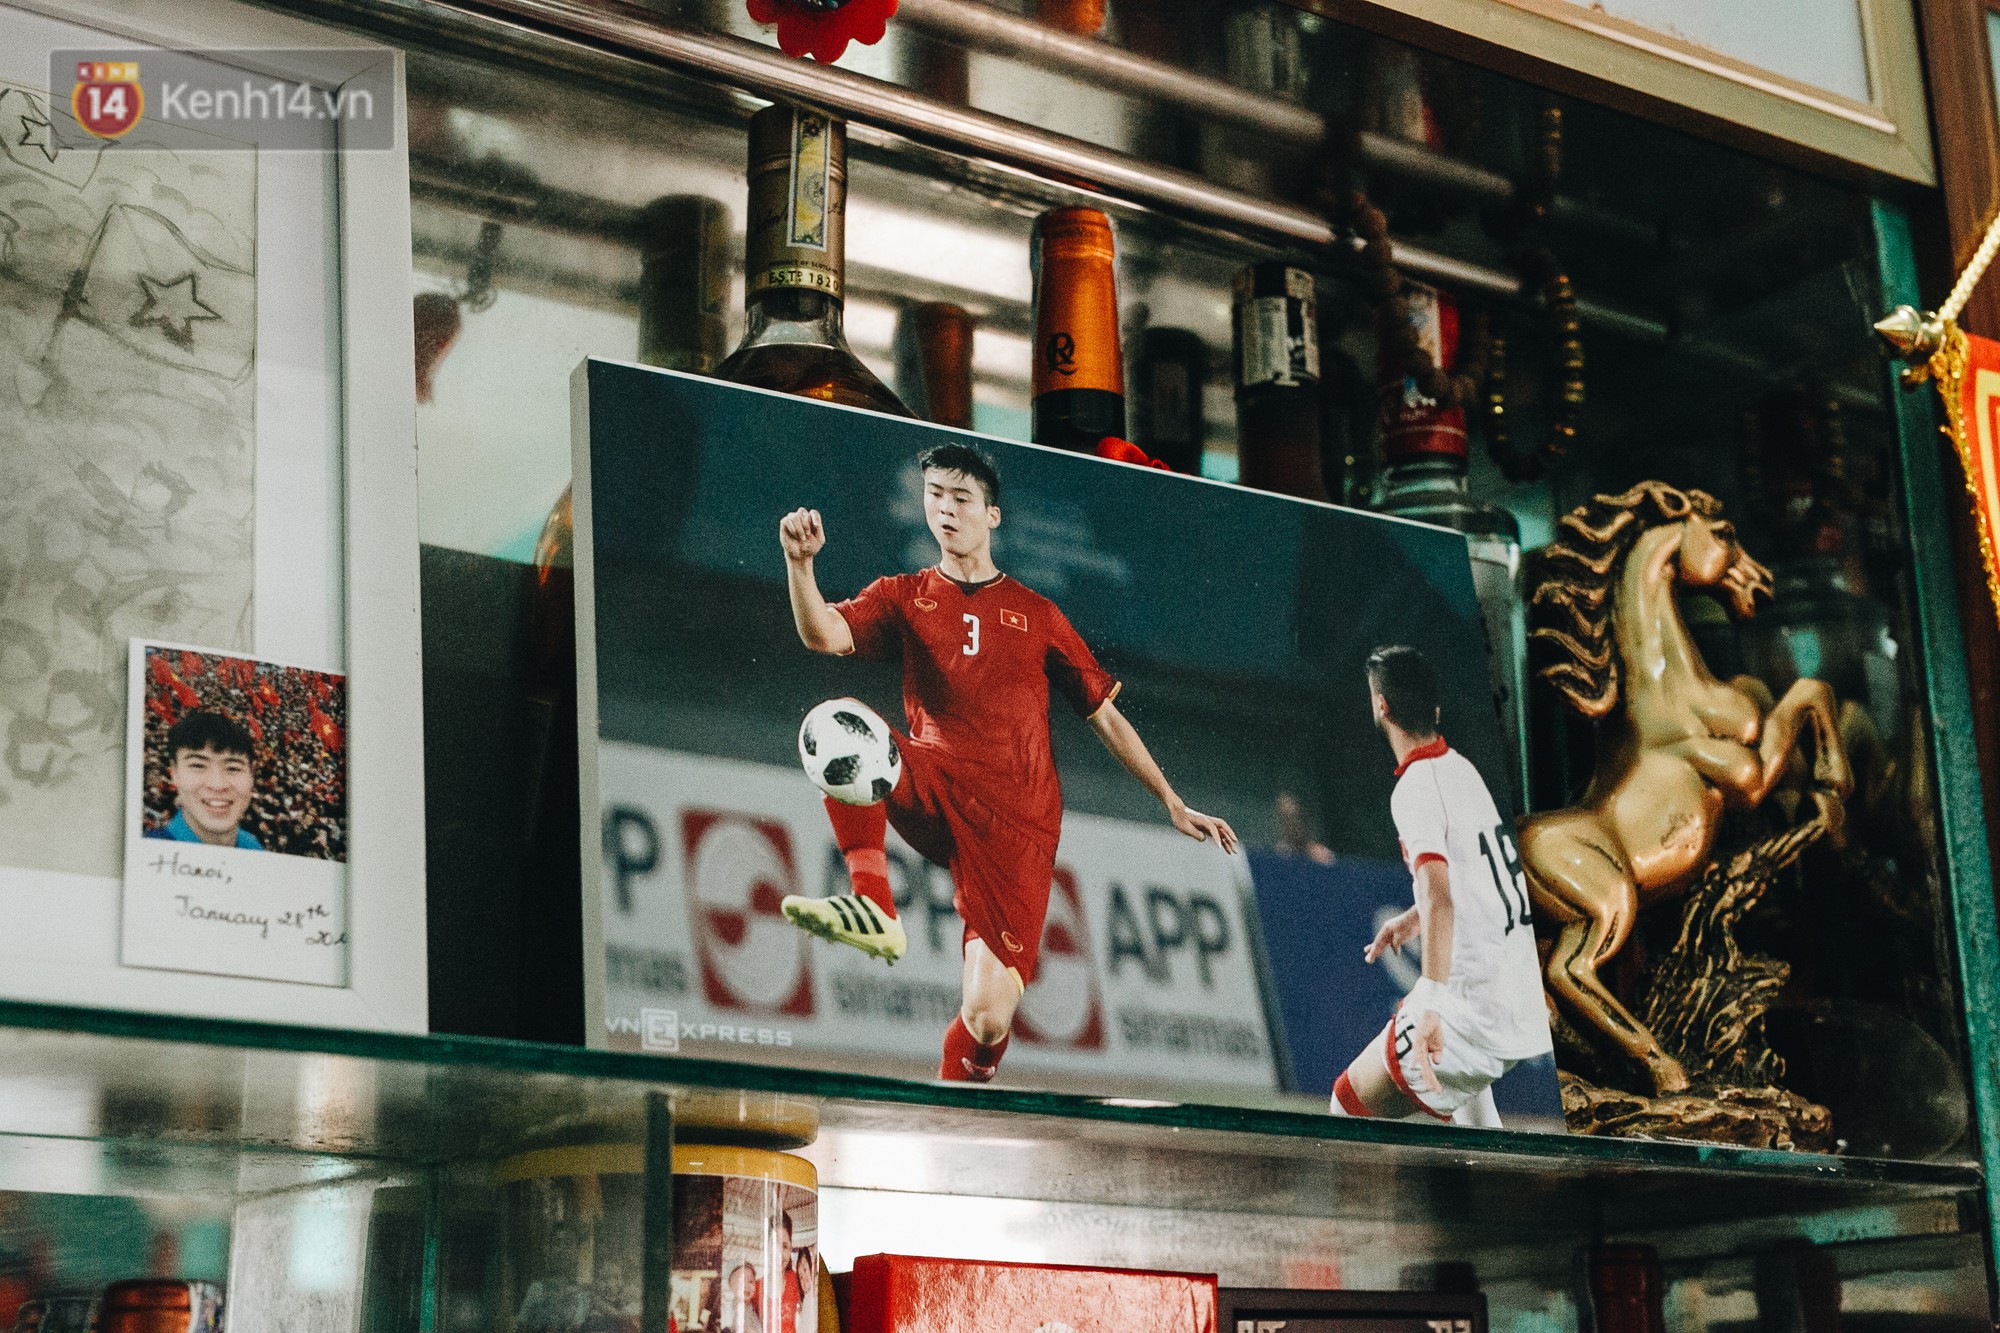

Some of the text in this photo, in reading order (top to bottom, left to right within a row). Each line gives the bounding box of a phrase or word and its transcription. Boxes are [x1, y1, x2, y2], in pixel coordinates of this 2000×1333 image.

[809, 272, 839, 291] 1820
[962, 612, 980, 656] 3
[175, 895, 268, 939] January
[1107, 881, 1230, 988] APP
